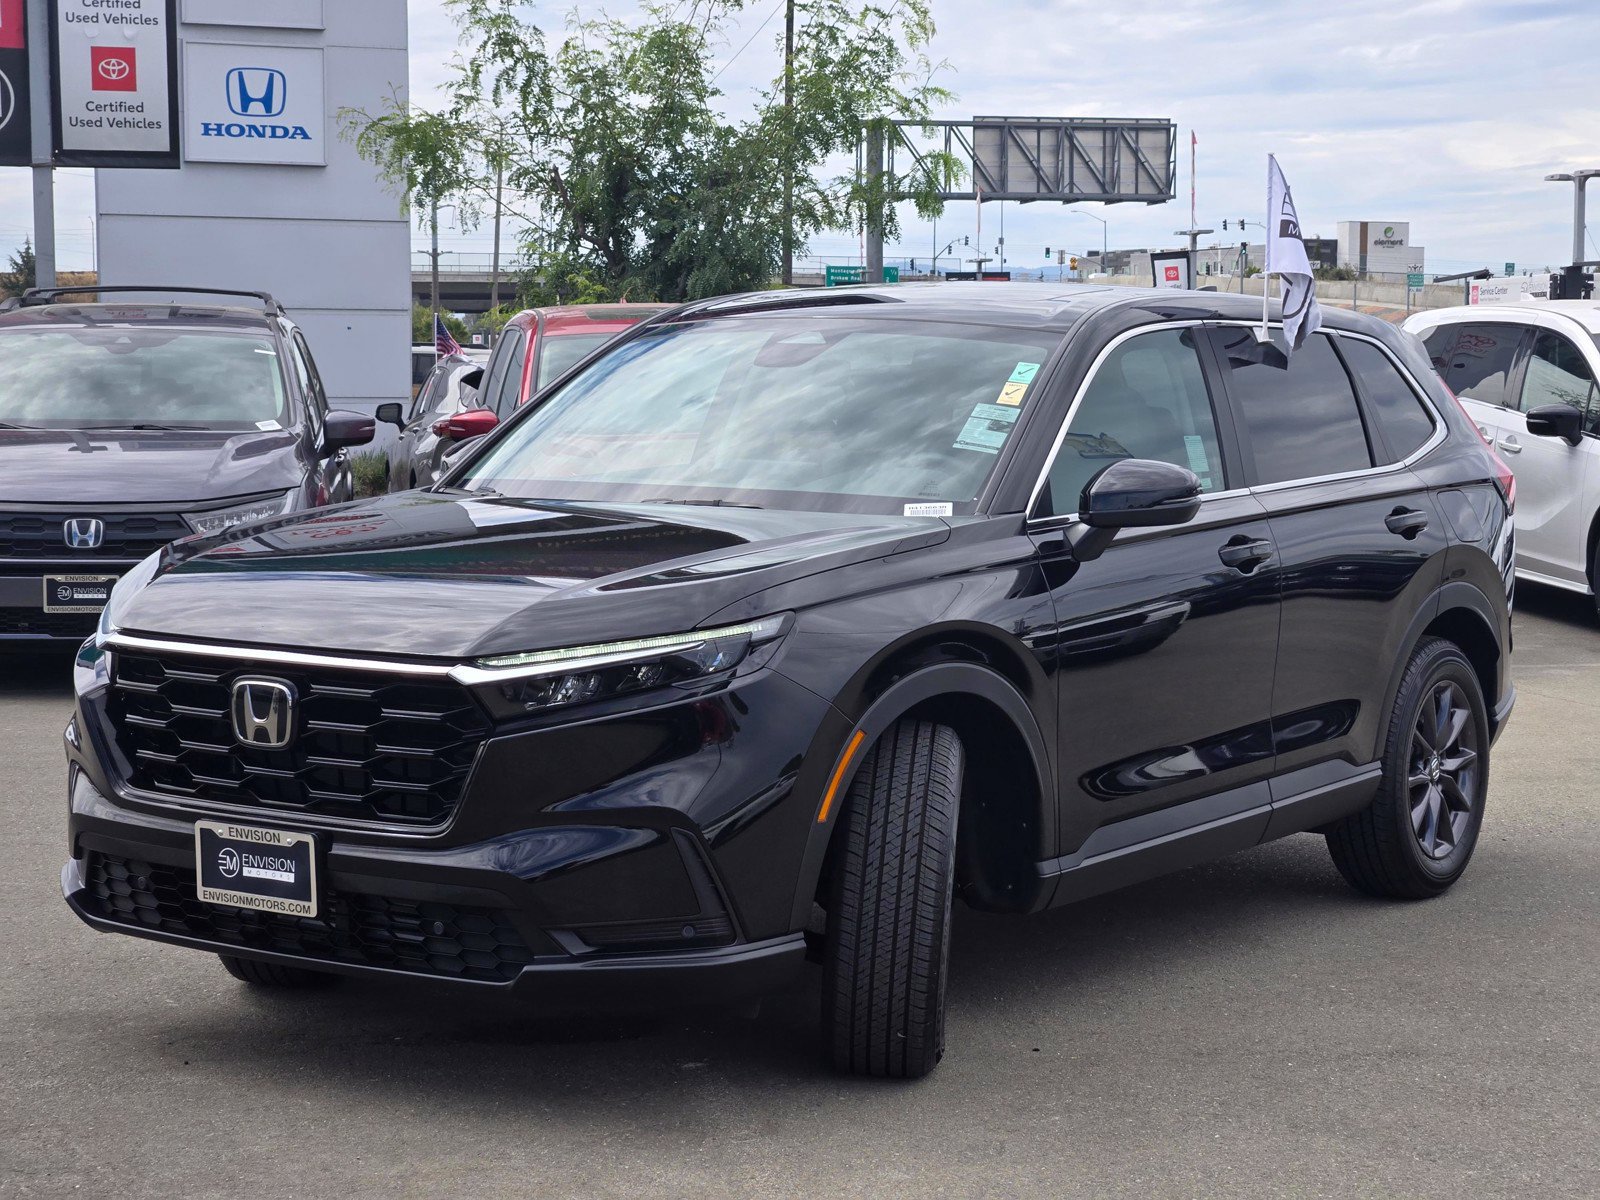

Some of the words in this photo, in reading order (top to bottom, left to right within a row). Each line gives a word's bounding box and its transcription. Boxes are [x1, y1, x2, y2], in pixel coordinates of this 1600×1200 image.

[82, 0, 141, 9] Certified
[65, 12, 99, 23] Used
[103, 13, 159, 25] Vehicles
[85, 101, 144, 113] Certified
[69, 116, 103, 128] Used
[106, 117, 162, 129] Vehicles
[201, 122, 312, 140] HONDA
[1374, 238, 1404, 246] element
[1479, 287, 1494, 296] Service
[1494, 286, 1508, 295] Center
[228, 827, 281, 843] ENVISION
[242, 853, 296, 873] ENVISION
[247, 869, 292, 881] MOTORS
[203, 890, 311, 914] ENVISIONMOTORS.COM
